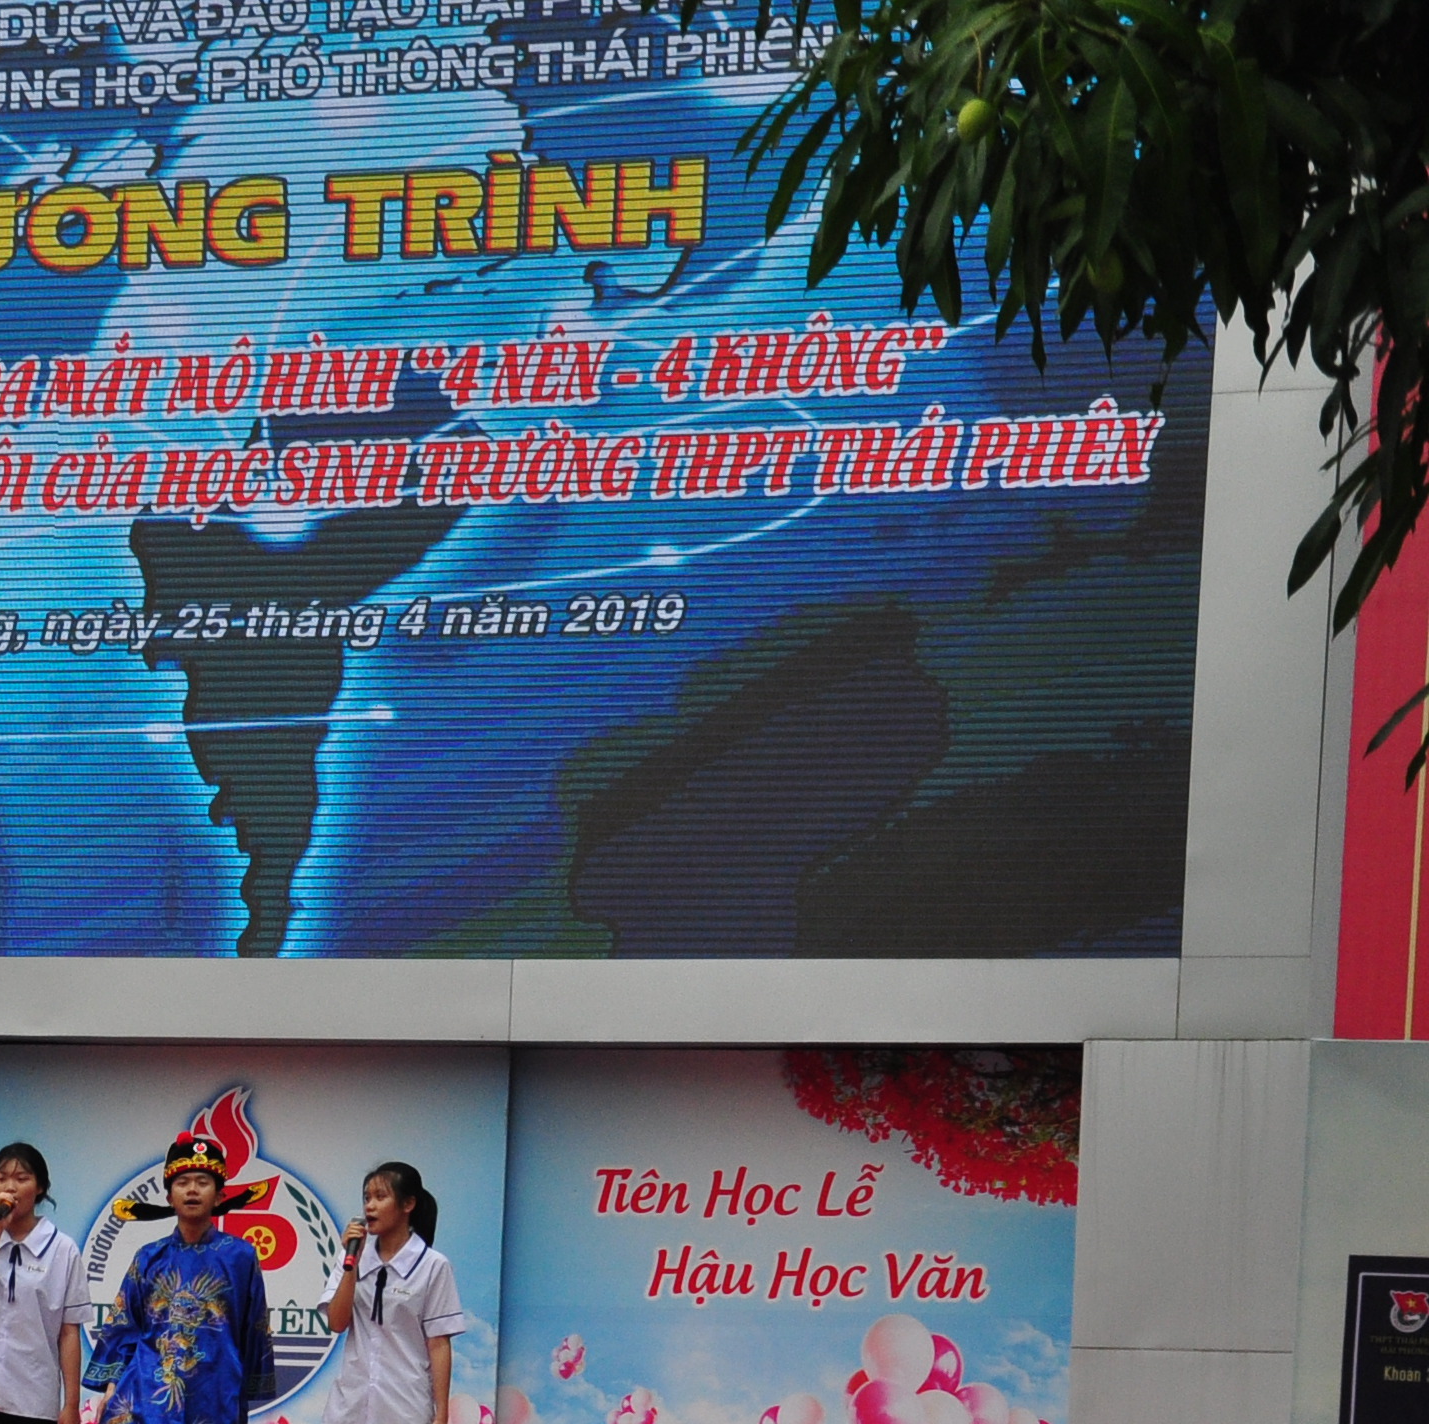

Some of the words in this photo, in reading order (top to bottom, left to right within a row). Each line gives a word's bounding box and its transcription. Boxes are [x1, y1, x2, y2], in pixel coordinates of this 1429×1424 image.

[92, 60, 198, 116] HỌC
[210, 37, 324, 103] PHỔ
[331, 37, 518, 95] THÔNG
[525, 27, 650, 84] THÁI
[325, 151, 708, 260] TRÌNH
[44, 331, 164, 418] MẮT
[165, 336, 255, 416] MÔ
[257, 332, 405, 415] HÌNH
[488, 324, 612, 406] NÊN
[652, 334, 699, 402] 4
[40, 433, 147, 512] CỦA
[149, 445, 272, 530] HỌC
[276, 440, 412, 508] SINH
[417, 419, 641, 506] TRƯỜNG
[649, 425, 813, 498] THPT
[815, 402, 965, 492] THÁI
[961, 396, 1164, 489] PHIÊN
[43, 599, 161, 654] ngày
[173, 603, 232, 643] 25
[244, 600, 385, 648] tháng
[397, 596, 432, 638] 4
[440, 595, 551, 638] năm
[562, 593, 688, 636] 2019
[126, 1176, 161, 1206] HPT
[594, 1168, 690, 1215] Tiên
[703, 1166, 802, 1226] Học
[816, 1163, 885, 1218] Lễ
[648, 1245, 754, 1305] Hậu
[767, 1247, 868, 1308] Học
[884, 1252, 988, 1300] Văn
